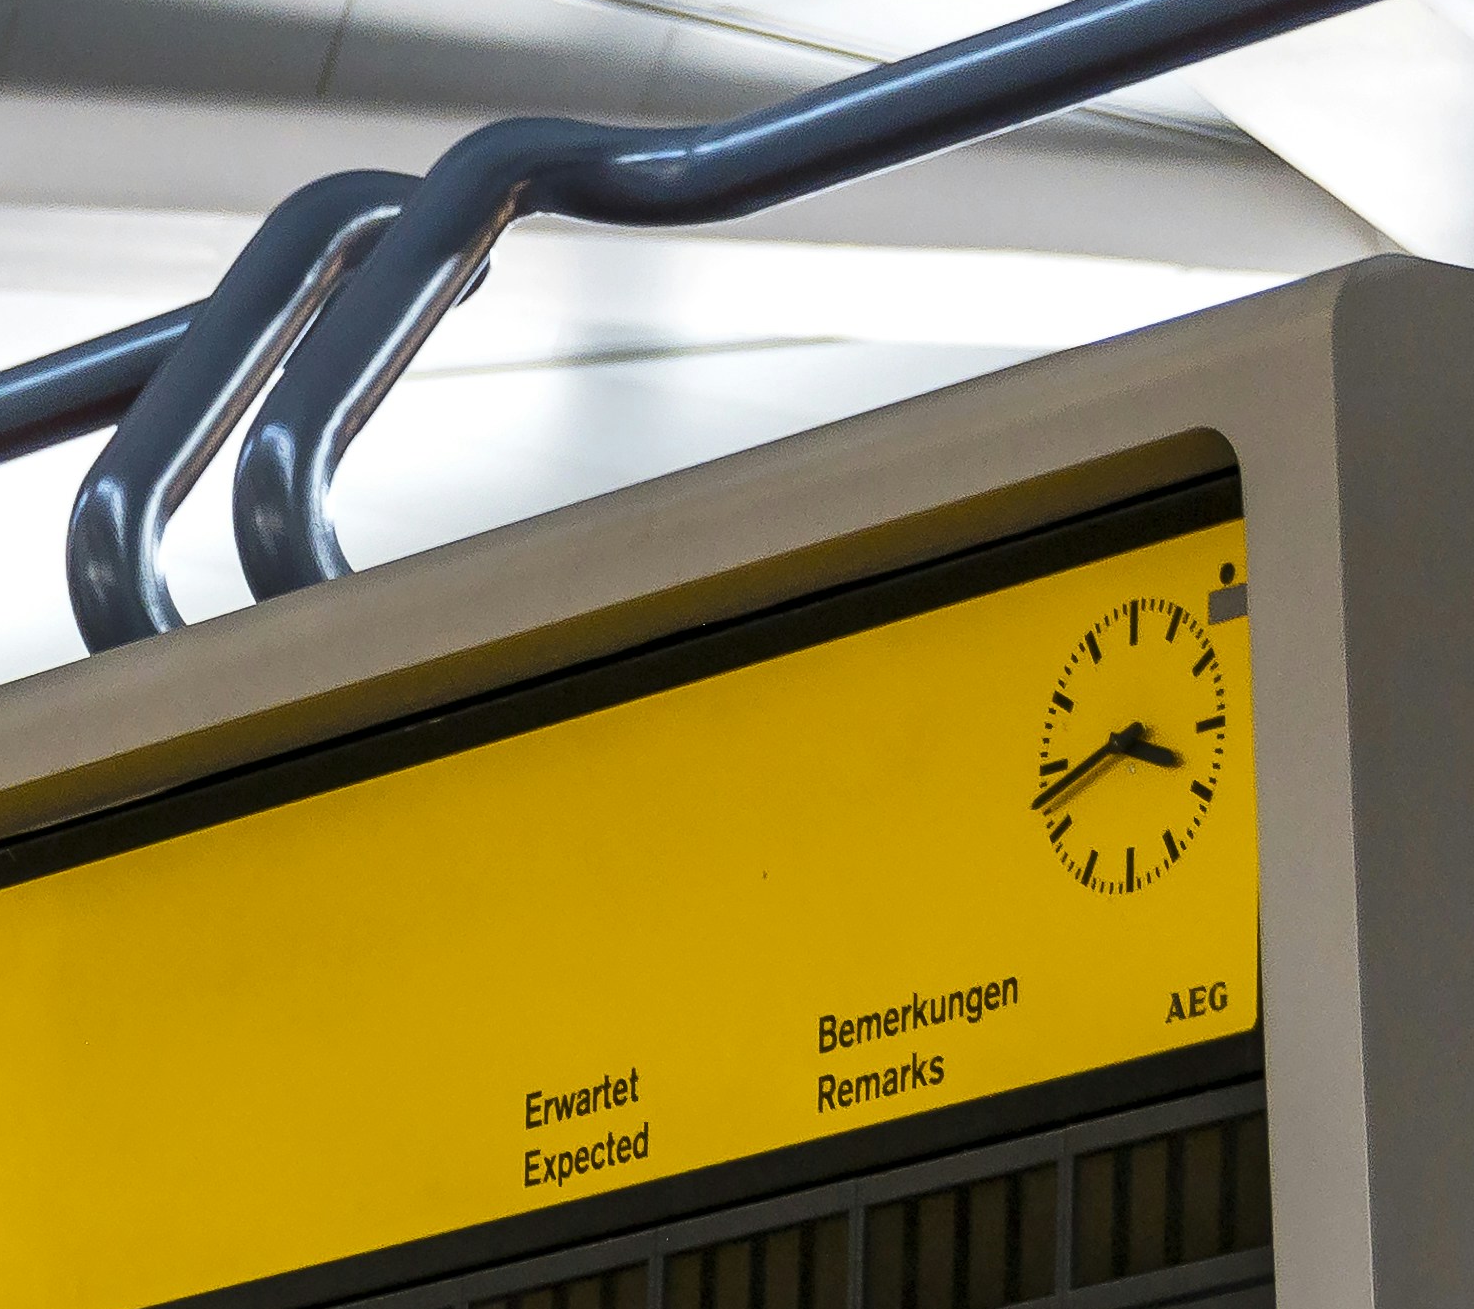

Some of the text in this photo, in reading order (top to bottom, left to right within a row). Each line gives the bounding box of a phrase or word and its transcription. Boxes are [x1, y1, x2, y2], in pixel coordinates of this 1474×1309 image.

[818, 976, 1019, 1054] Bemerkungen
[1164, 981, 1228, 1024] AEG
[525, 1067, 639, 1130] Erwartet
[817, 1052, 945, 1114] Remarks
[524, 1121, 649, 1189] Expected
